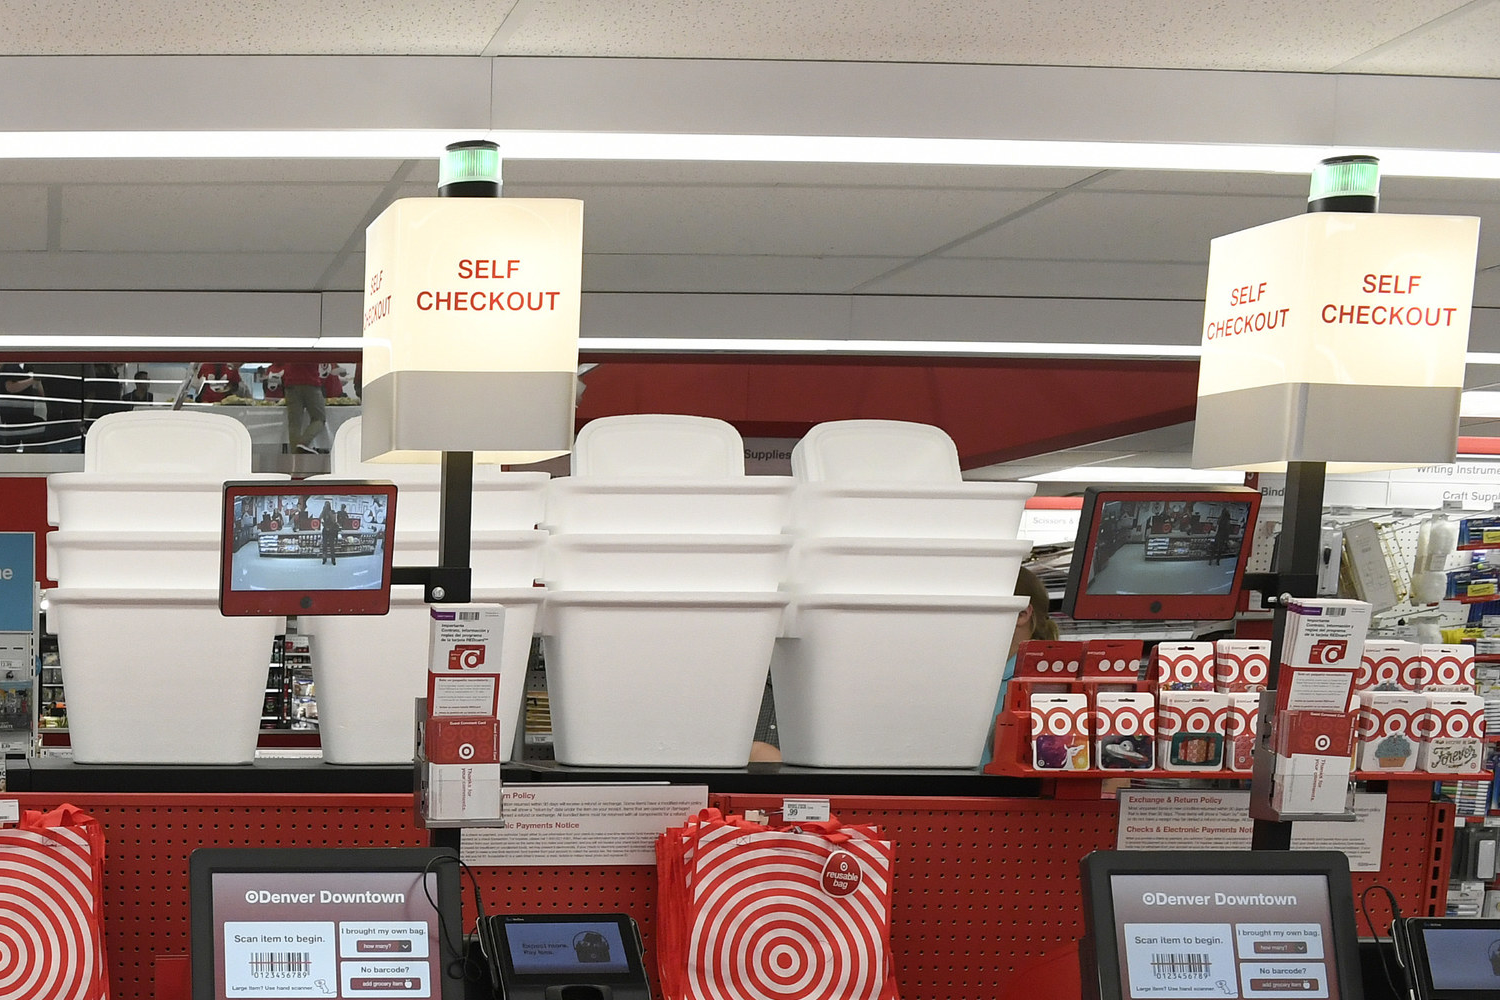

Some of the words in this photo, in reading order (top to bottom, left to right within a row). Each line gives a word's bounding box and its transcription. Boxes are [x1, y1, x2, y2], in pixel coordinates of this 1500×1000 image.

[458, 259, 520, 279] SELF
[370, 270, 383, 295] SELF
[1362, 274, 1421, 294] SELF
[1230, 283, 1267, 306] SELF
[417, 291, 560, 311] CHECKOUT
[1322, 304, 1457, 326] CHECKOUT
[1207, 309, 1289, 340] CHECKOUT
[744, 449, 791, 460] Supplies
[1417, 465, 1453, 475] Writing
[1443, 491, 1468, 501] Craft
[513, 792, 535, 800] Policy
[1202, 826, 1236, 834] Payments
[826, 872, 858, 882] reusable
[833, 879, 848, 889] bag
[260, 890, 315, 904] Denver
[320, 890, 405, 904] Downtown
[1157, 893, 1210, 906] Denver
[1215, 893, 1297, 906] Downtown
[234, 935, 258, 943] Scan
[261, 935, 281, 943] item
[296, 935, 325, 944] begin.
[1135, 936, 1158, 944] Scan
[1195, 937, 1223, 946] begin.
